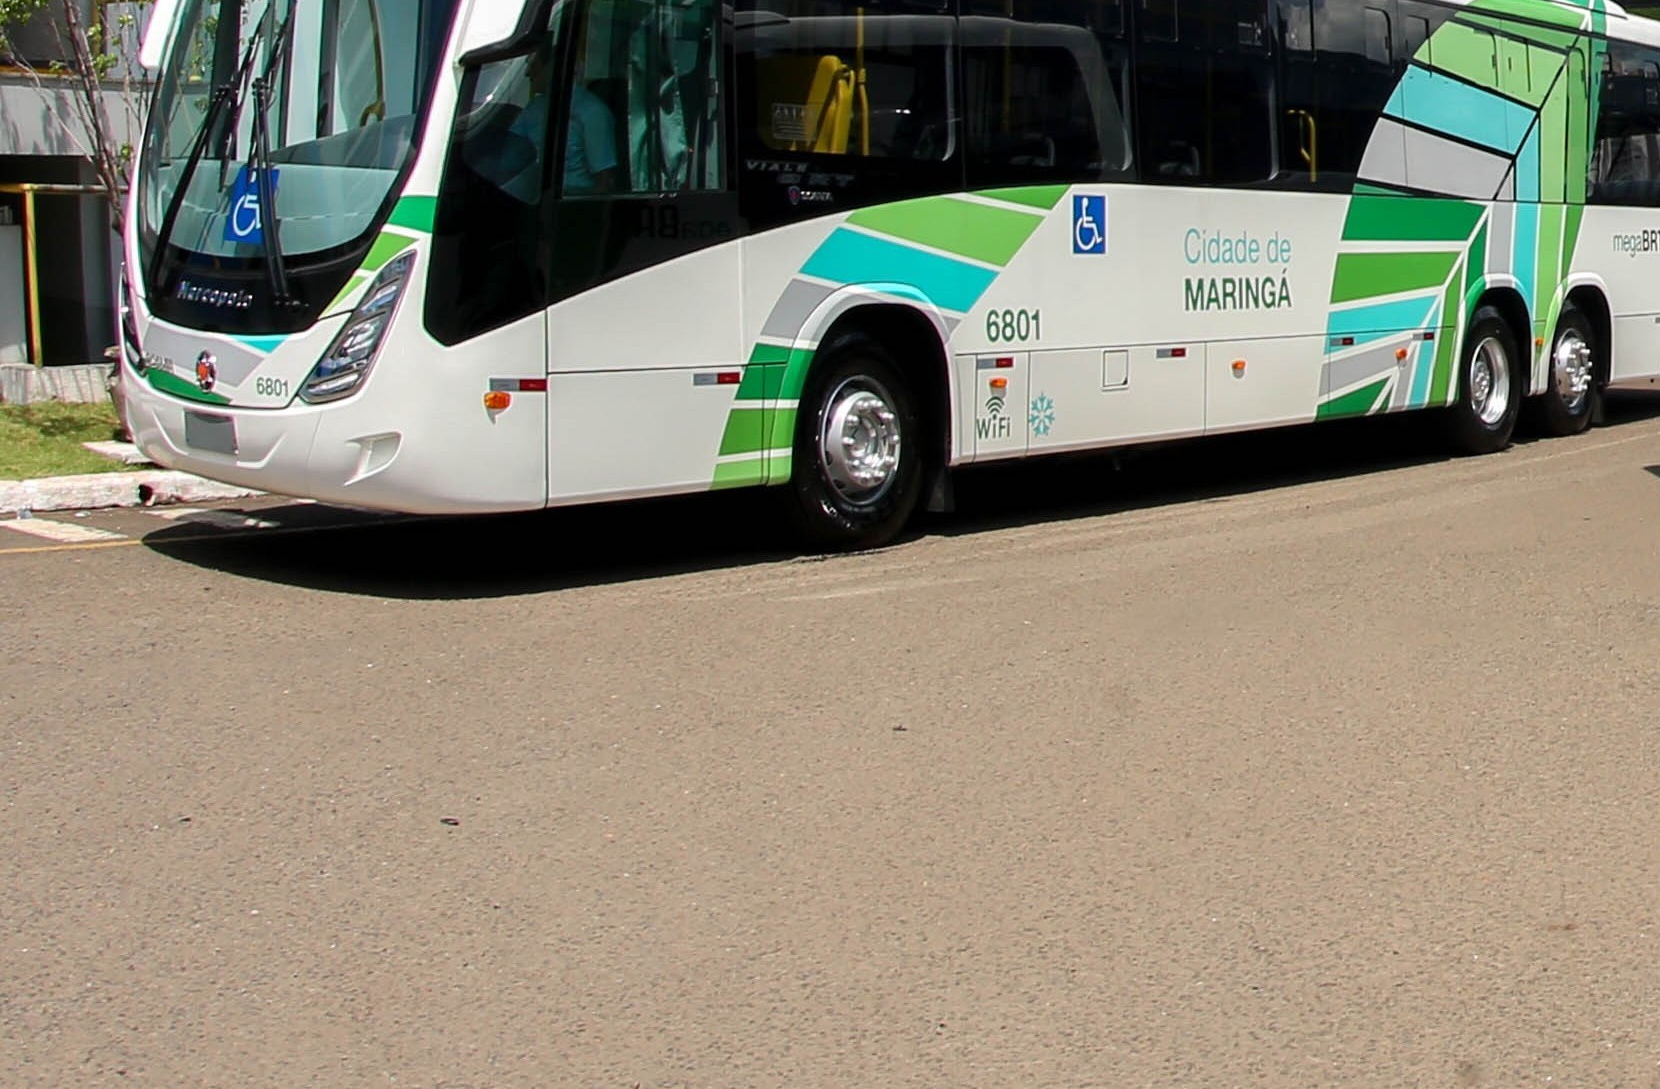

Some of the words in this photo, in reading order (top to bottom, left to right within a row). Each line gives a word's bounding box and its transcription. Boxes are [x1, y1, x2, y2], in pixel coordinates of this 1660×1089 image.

[1184, 227, 1260, 264] Cidade
[1266, 230, 1291, 264] de
[1184, 267, 1292, 311] MARINGÁ
[986, 308, 1041, 342] 6801
[256, 376, 289, 398] 6801
[976, 413, 1011, 440] WiFi
